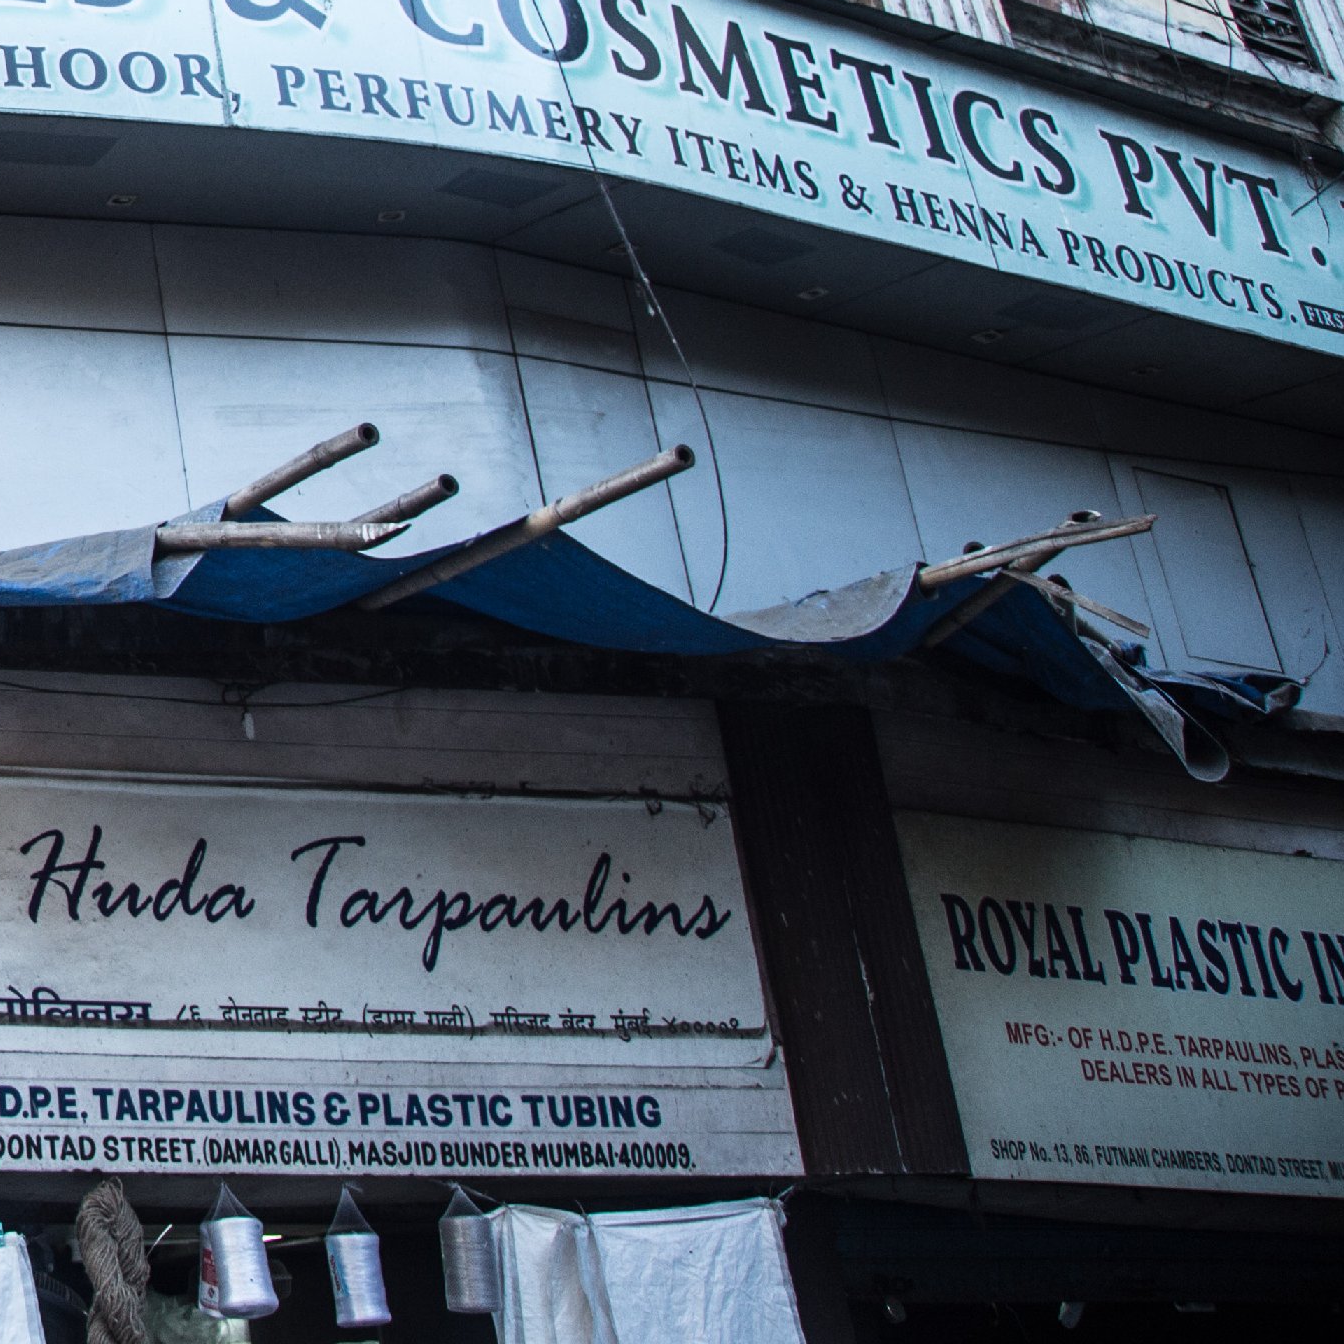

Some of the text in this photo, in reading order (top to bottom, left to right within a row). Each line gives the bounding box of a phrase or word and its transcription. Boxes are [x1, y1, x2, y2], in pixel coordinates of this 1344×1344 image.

[271, 63, 645, 159] PERFUMERY
[665, 124, 820, 203] ITEMS
[839, 175, 874, 216] &
[885, 182, 1049, 260] HENNA
[1057, 227, 1299, 324] PRODUCTS.
[1100, 130, 1329, 268] PVT.
[1305, 305, 1344, 330] FIRS
[19, 823, 732, 973] Huda Tarpaulins
[939, 892, 1107, 986] ROYAL
[1103, 908, 1304, 1003] PLASTIC
[1067, 1025, 1093, 1050] OF
[1099, 1028, 1173, 1057] H.D.P.E.
[1175, 1034, 1298, 1071] TARPAULINS,
[1080, 1058, 1173, 1087] DEALERS
[1176, 1065, 1197, 1088] IN
[1201, 1067, 1238, 1093] ALL
[1239, 1070, 1301, 1098] TYPES
[1304, 1076, 1329, 1101] OF
[92, 1087, 315, 1126] TARPAULINS
[323, 1092, 351, 1124] &
[358, 1092, 514, 1128] PLASTIC
[521, 1094, 663, 1129] TUBING
[348, 1138, 437, 1169] MASJID
[441, 1140, 530, 1169] BUNDER
[990, 1138, 1026, 1161] SHOP
[1029, 1141, 1052, 1163] No.
[1053, 1142, 1074, 1166] 13,
[1074, 1144, 1094, 1167] 86,
[1094, 1145, 1150, 1169] FUTNANI
[1151, 1146, 1226, 1176] CHAMBERS,
[1226, 1153, 1276, 1177] DONTAD
